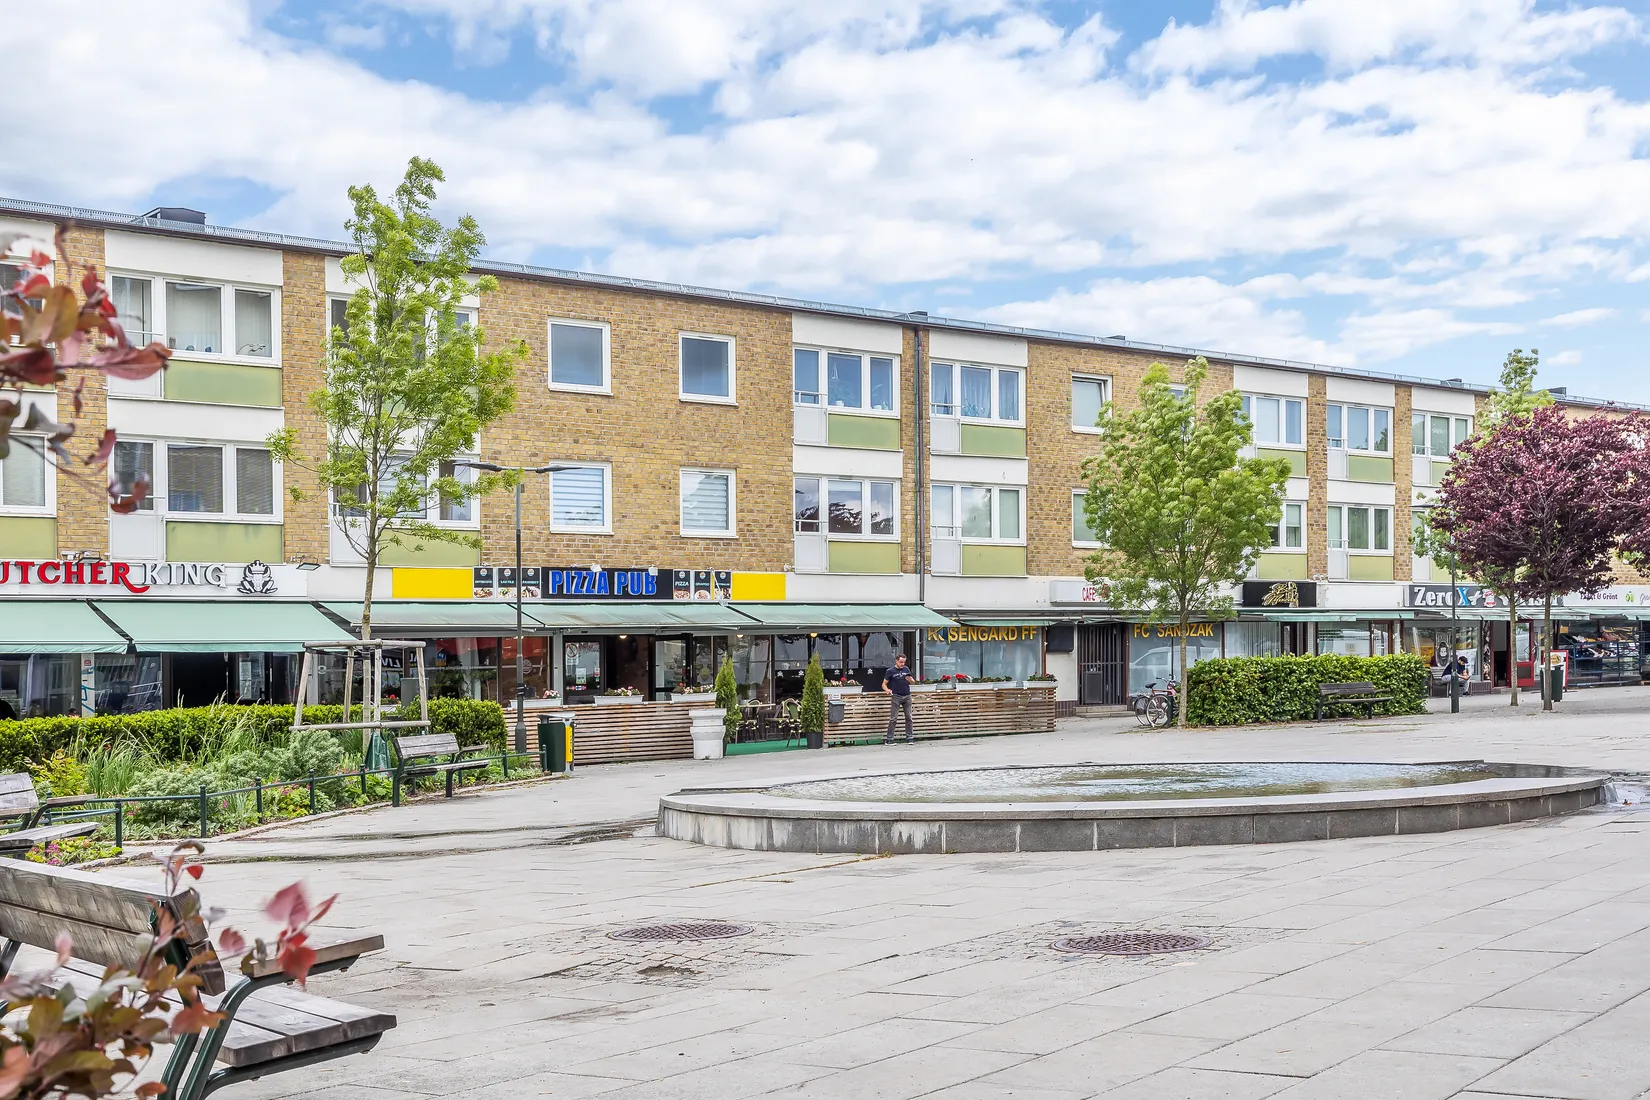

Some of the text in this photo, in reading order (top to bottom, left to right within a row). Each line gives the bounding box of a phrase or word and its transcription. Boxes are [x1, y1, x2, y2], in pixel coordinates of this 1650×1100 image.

[142, 563, 227, 588] KING
[548, 570, 657, 596] PIZZA PUB
[1021, 625, 1038, 640] FF
[1133, 623, 1150, 638] FC
